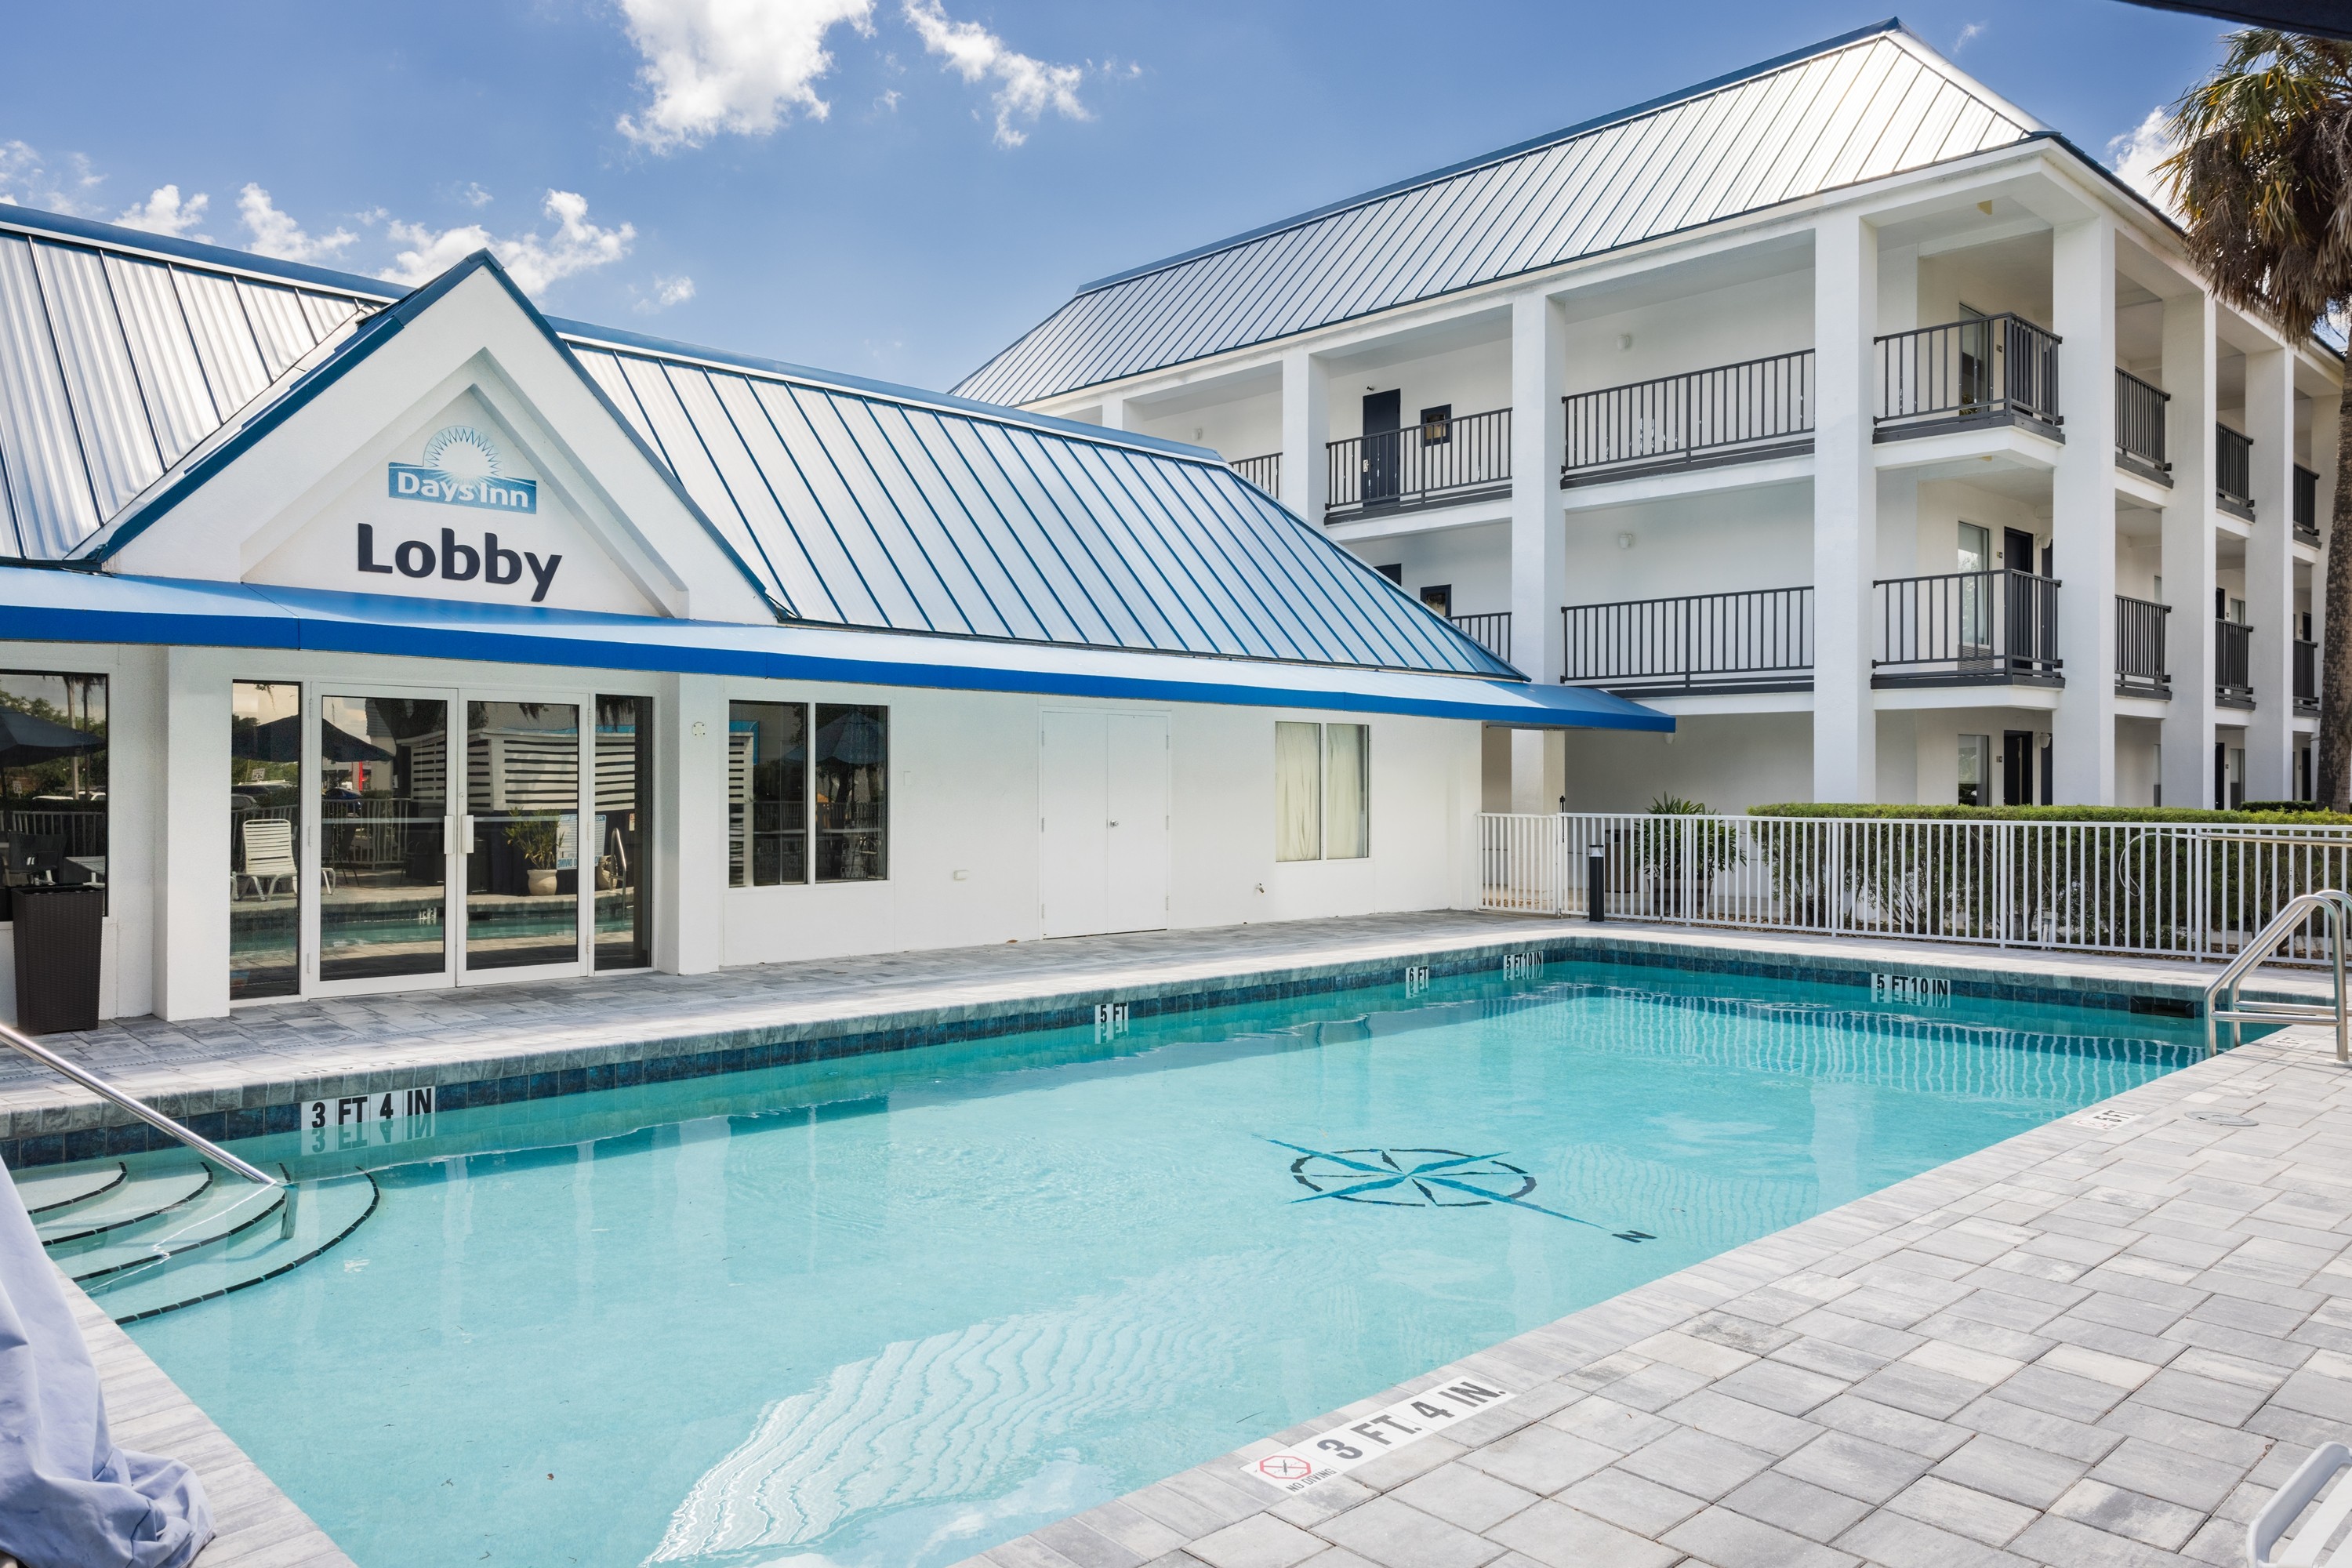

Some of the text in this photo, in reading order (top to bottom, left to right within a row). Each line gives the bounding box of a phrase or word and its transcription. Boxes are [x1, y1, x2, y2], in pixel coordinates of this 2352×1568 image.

[397, 471, 528, 508] Days Inn
[358, 523, 562, 602] Lobby
[1506, 952, 1542, 969] 5 FT 10 IN
[1409, 966, 1428, 982] 6 FT
[1877, 974, 1948, 995] 5 FT 10 IN
[1100, 1003, 1127, 1023] 5 FT
[311, 1088, 432, 1129] 3 FT 4 IN
[1316, 1381, 1506, 1459] 3 FT. 4 IN.
[1286, 1468, 1338, 1492] NO DIVING
